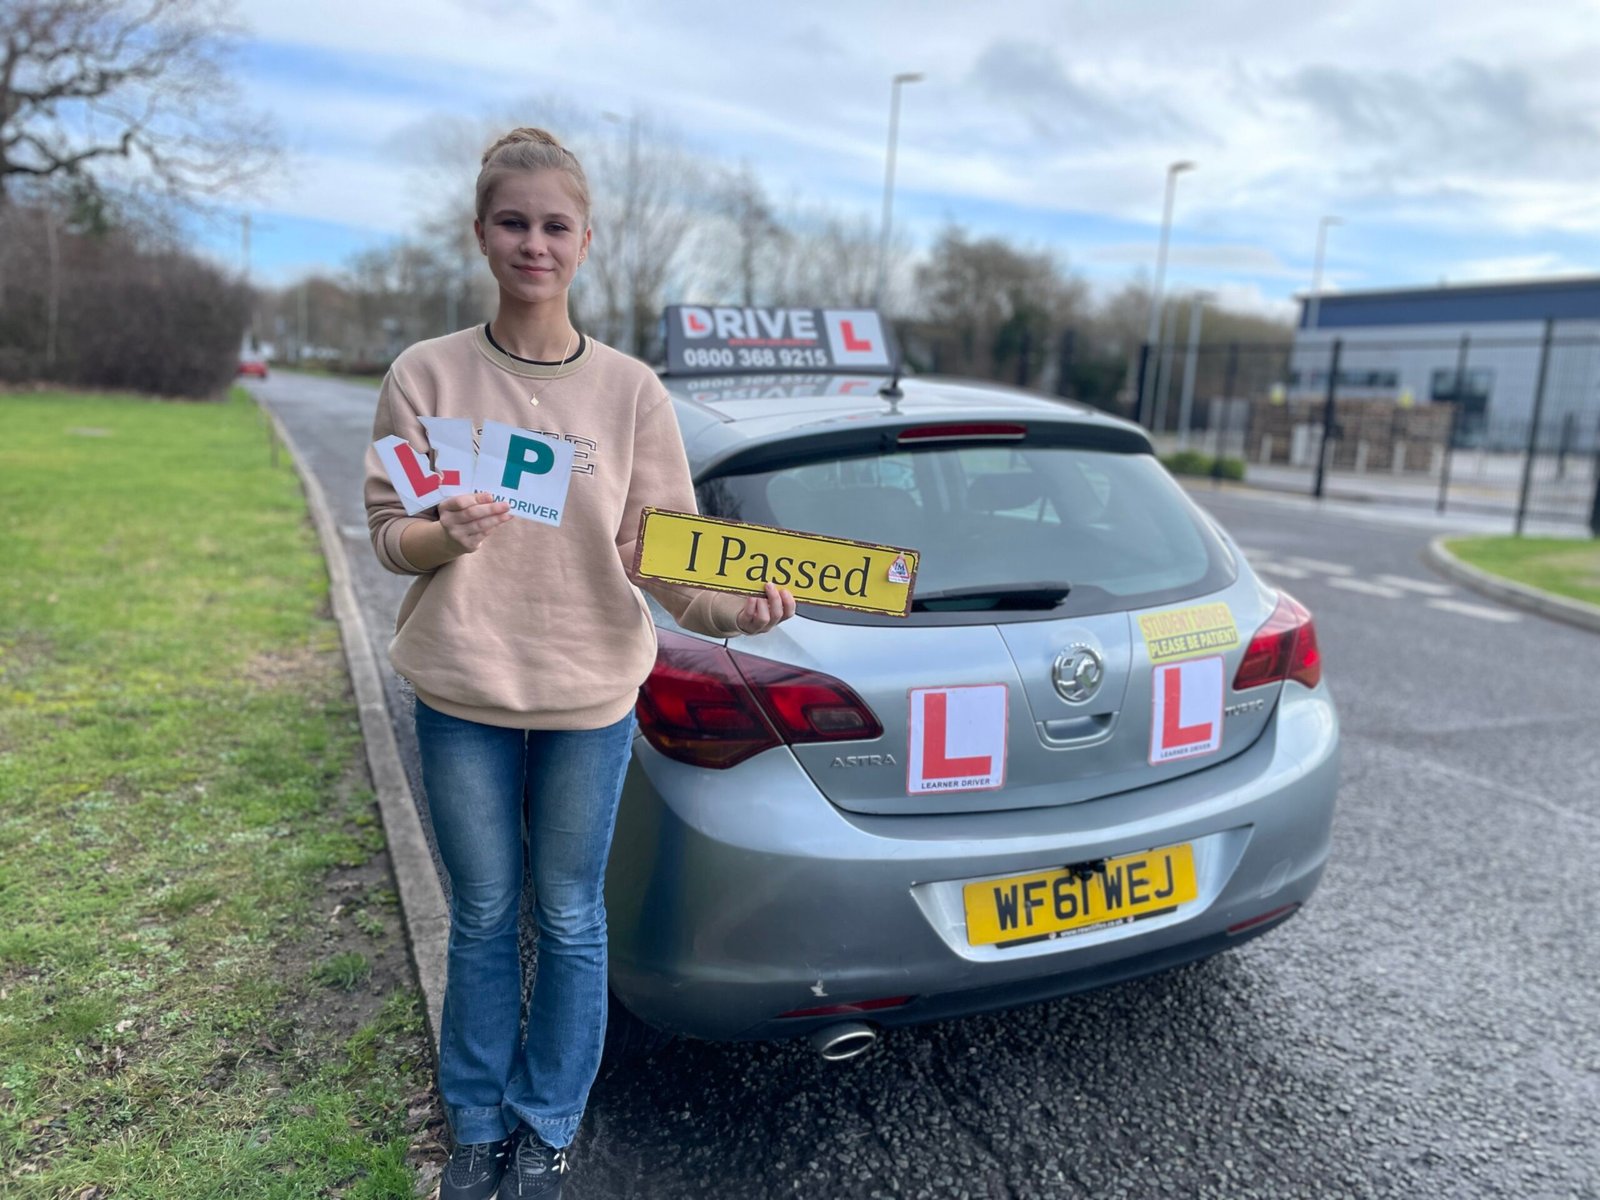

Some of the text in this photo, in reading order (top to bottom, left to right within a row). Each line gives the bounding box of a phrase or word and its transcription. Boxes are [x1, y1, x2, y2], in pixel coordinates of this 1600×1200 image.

[680, 307, 818, 339] DRIVE
[839, 320, 873, 352] L
[683, 348, 828, 367] 0800 368 9215
[393, 441, 461, 498] L
[501, 433, 555, 490] P
[508, 497, 559, 521] DRIVER
[685, 530, 871, 598] I Passed
[1149, 629, 1236, 657] PLEASE BE PATIENT
[1162, 667, 1213, 749] L
[922, 692, 992, 780] L
[829, 753, 897, 769] ASTRA
[1160, 746, 1189, 759] LEARNER
[921, 777, 991, 790] LEARNER DRIVER
[993, 854, 1175, 931] WF61 WEJ
